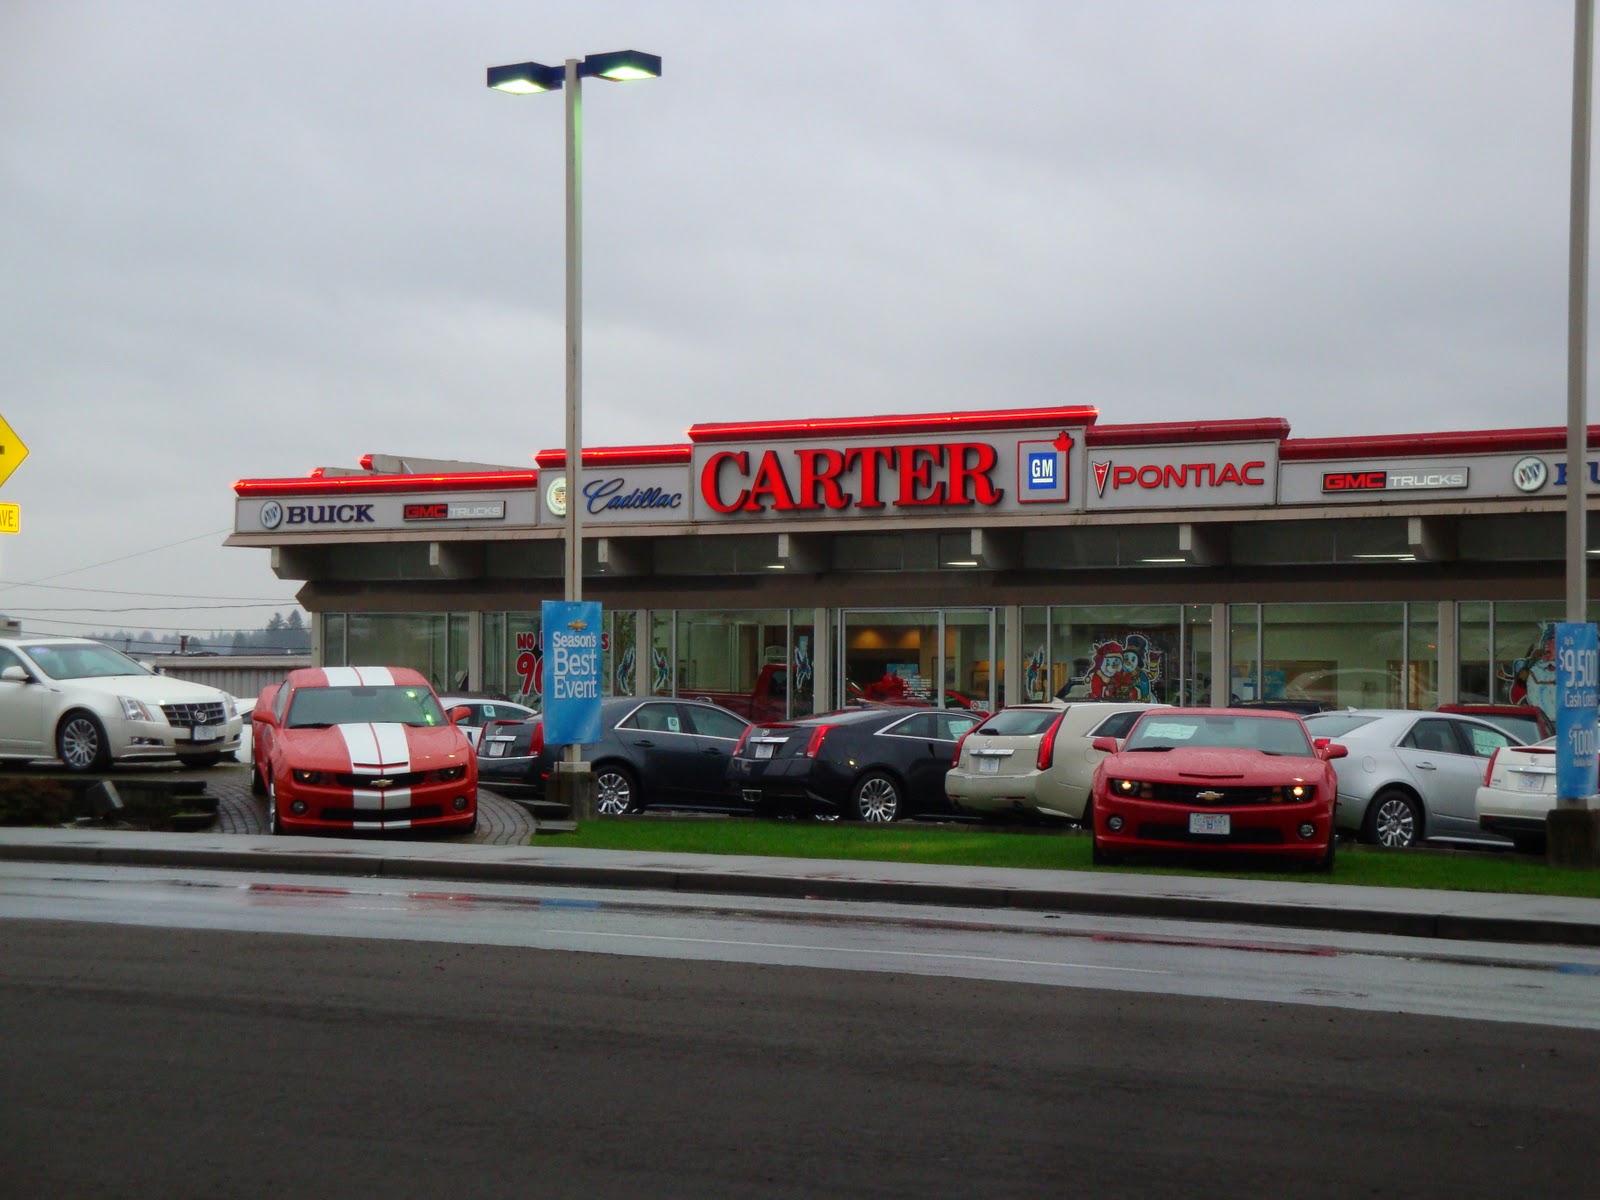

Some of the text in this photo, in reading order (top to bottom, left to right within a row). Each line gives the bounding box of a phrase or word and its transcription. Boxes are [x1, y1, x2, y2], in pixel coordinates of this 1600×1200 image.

[700, 442, 1003, 514] CARTER
[1031, 458, 1054, 478] GM
[1113, 461, 1265, 490] PONTIAC
[1325, 472, 1463, 490] GMC TRUCKS
[582, 477, 682, 514] Cadillac
[286, 504, 375, 524] BUICK
[405, 504, 501, 518] GMC TRUCKS
[516, 631, 535, 650] NO
[552, 631, 597, 648] Season's
[553, 647, 597, 676] Best
[1558, 646, 1597, 689] $9,500
[553, 675, 598, 699] Event
[1564, 690, 1582, 708] Cash
